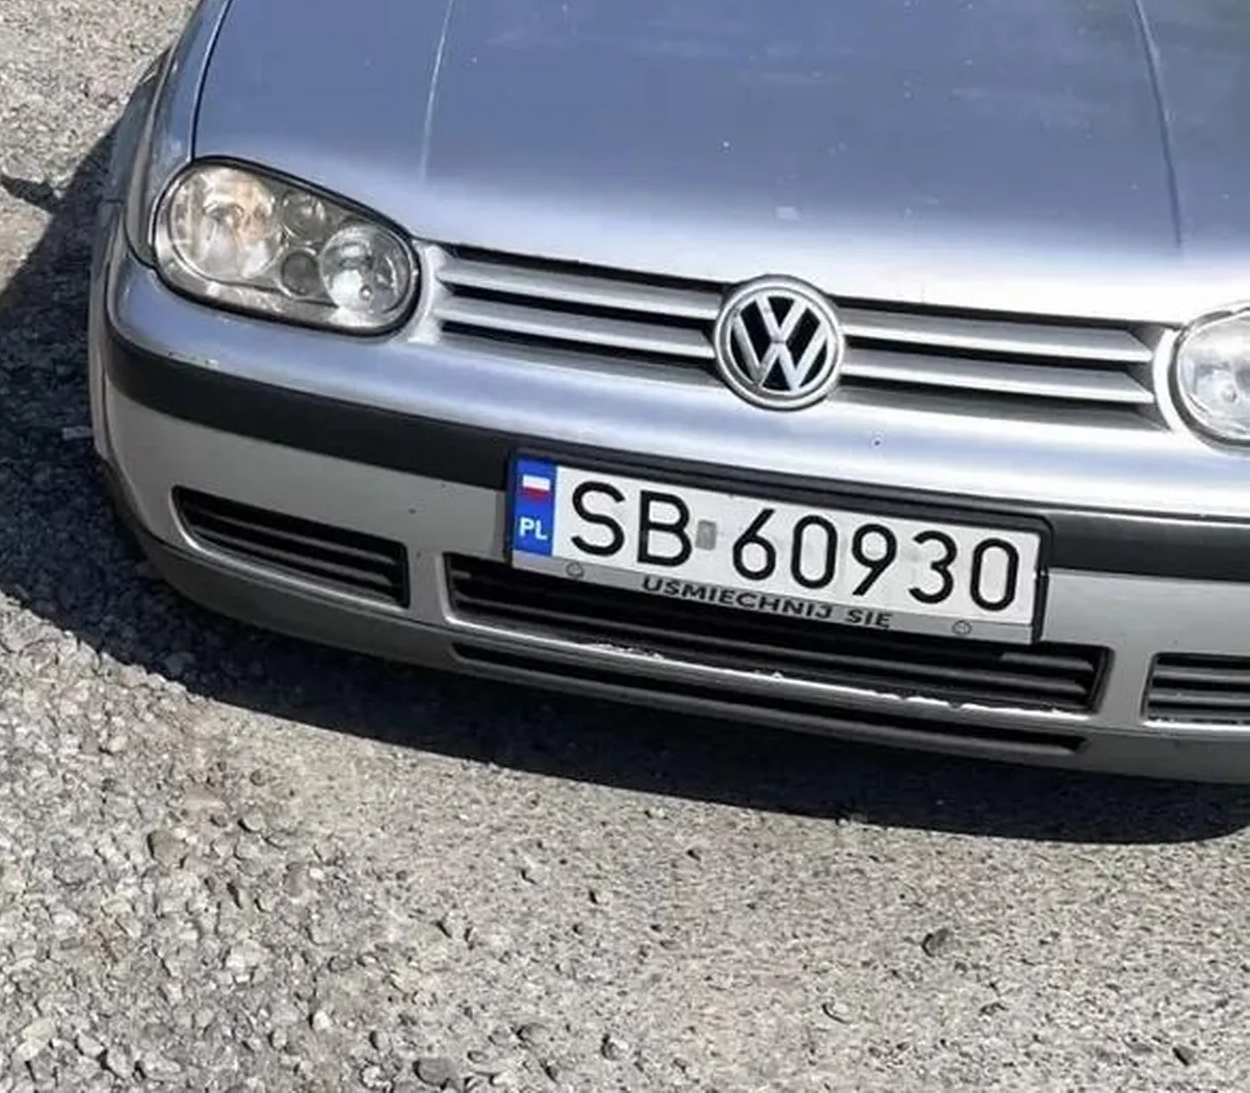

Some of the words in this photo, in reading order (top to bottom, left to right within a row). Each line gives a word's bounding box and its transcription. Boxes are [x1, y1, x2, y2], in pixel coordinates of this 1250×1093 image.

[519, 516, 549, 541] PL
[570, 480, 692, 567] SB
[732, 507, 1020, 611] 60930
